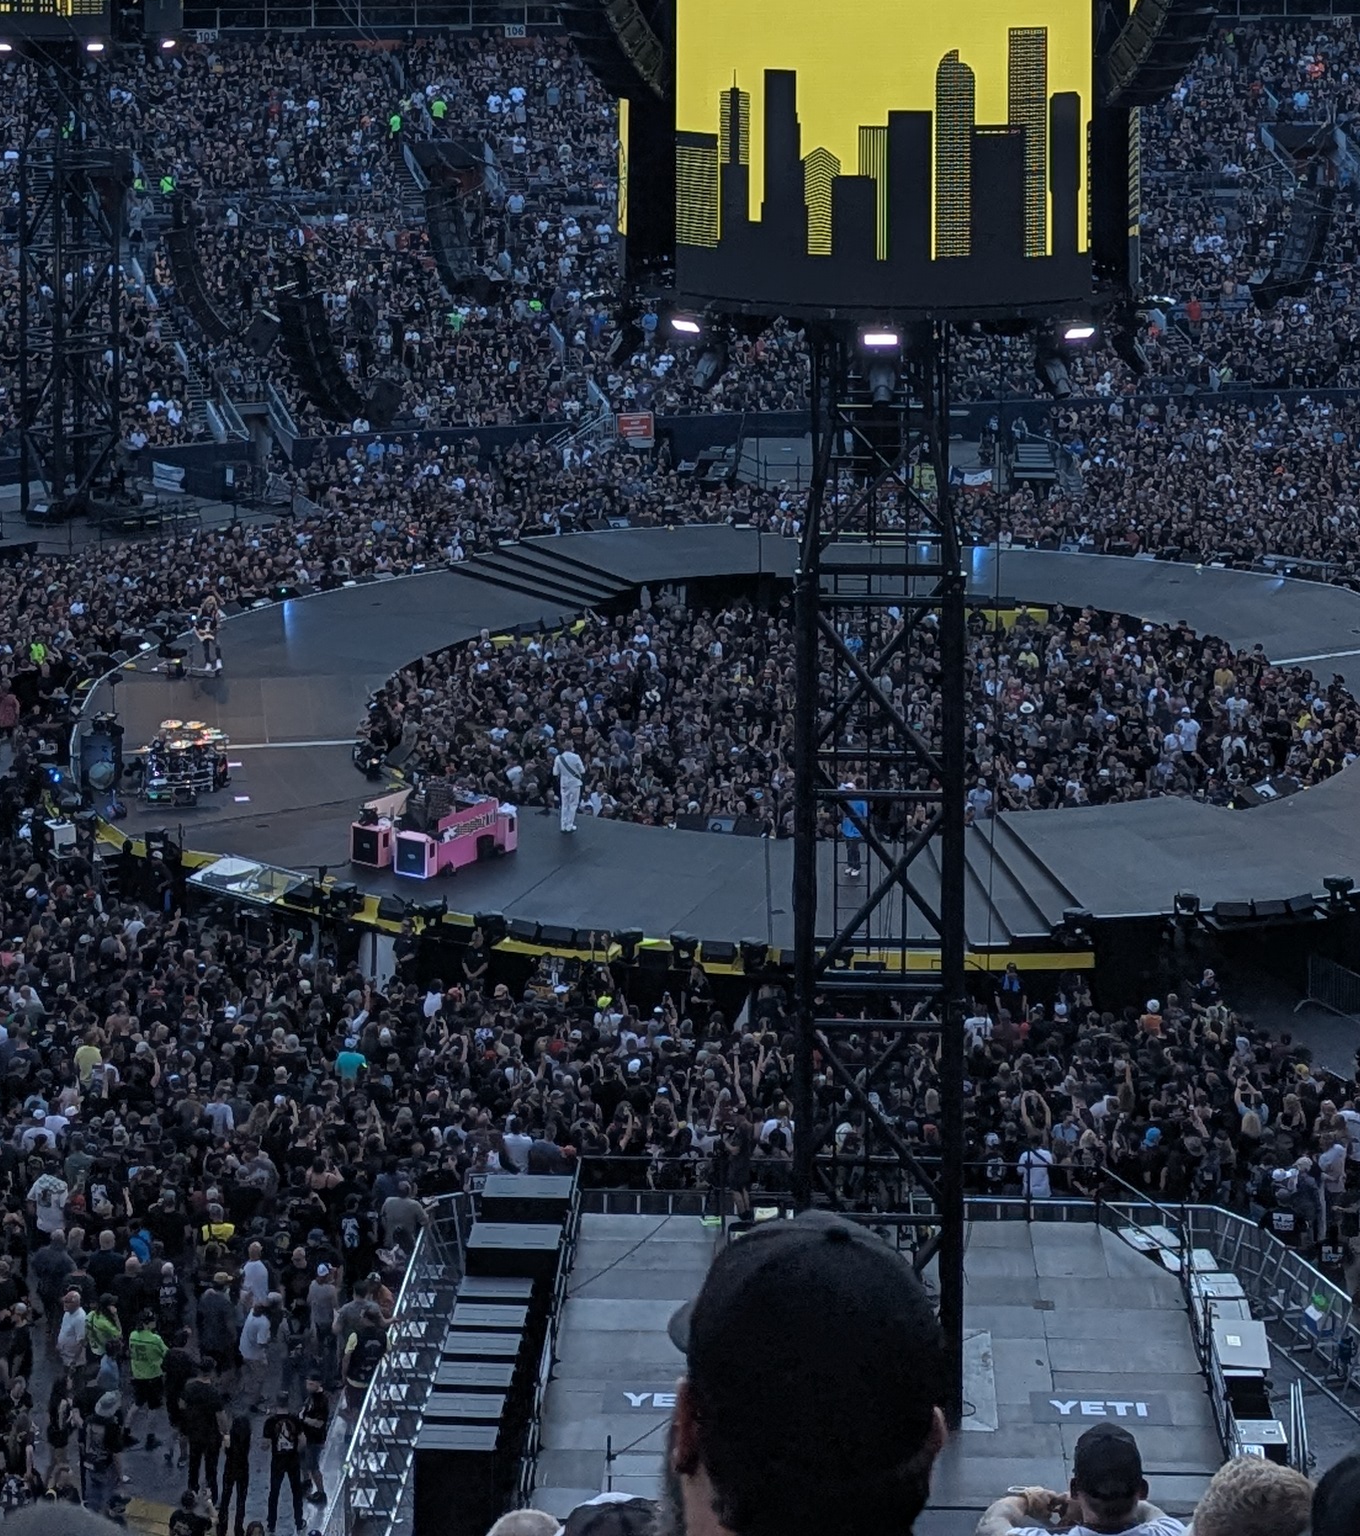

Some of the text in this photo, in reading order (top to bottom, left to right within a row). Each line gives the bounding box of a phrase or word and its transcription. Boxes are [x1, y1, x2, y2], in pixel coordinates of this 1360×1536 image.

[199, 31, 216, 42] 105
[507, 26, 524, 36] 106
[623, 1392, 677, 1407] YE
[1049, 1400, 1149, 1416] YETI
